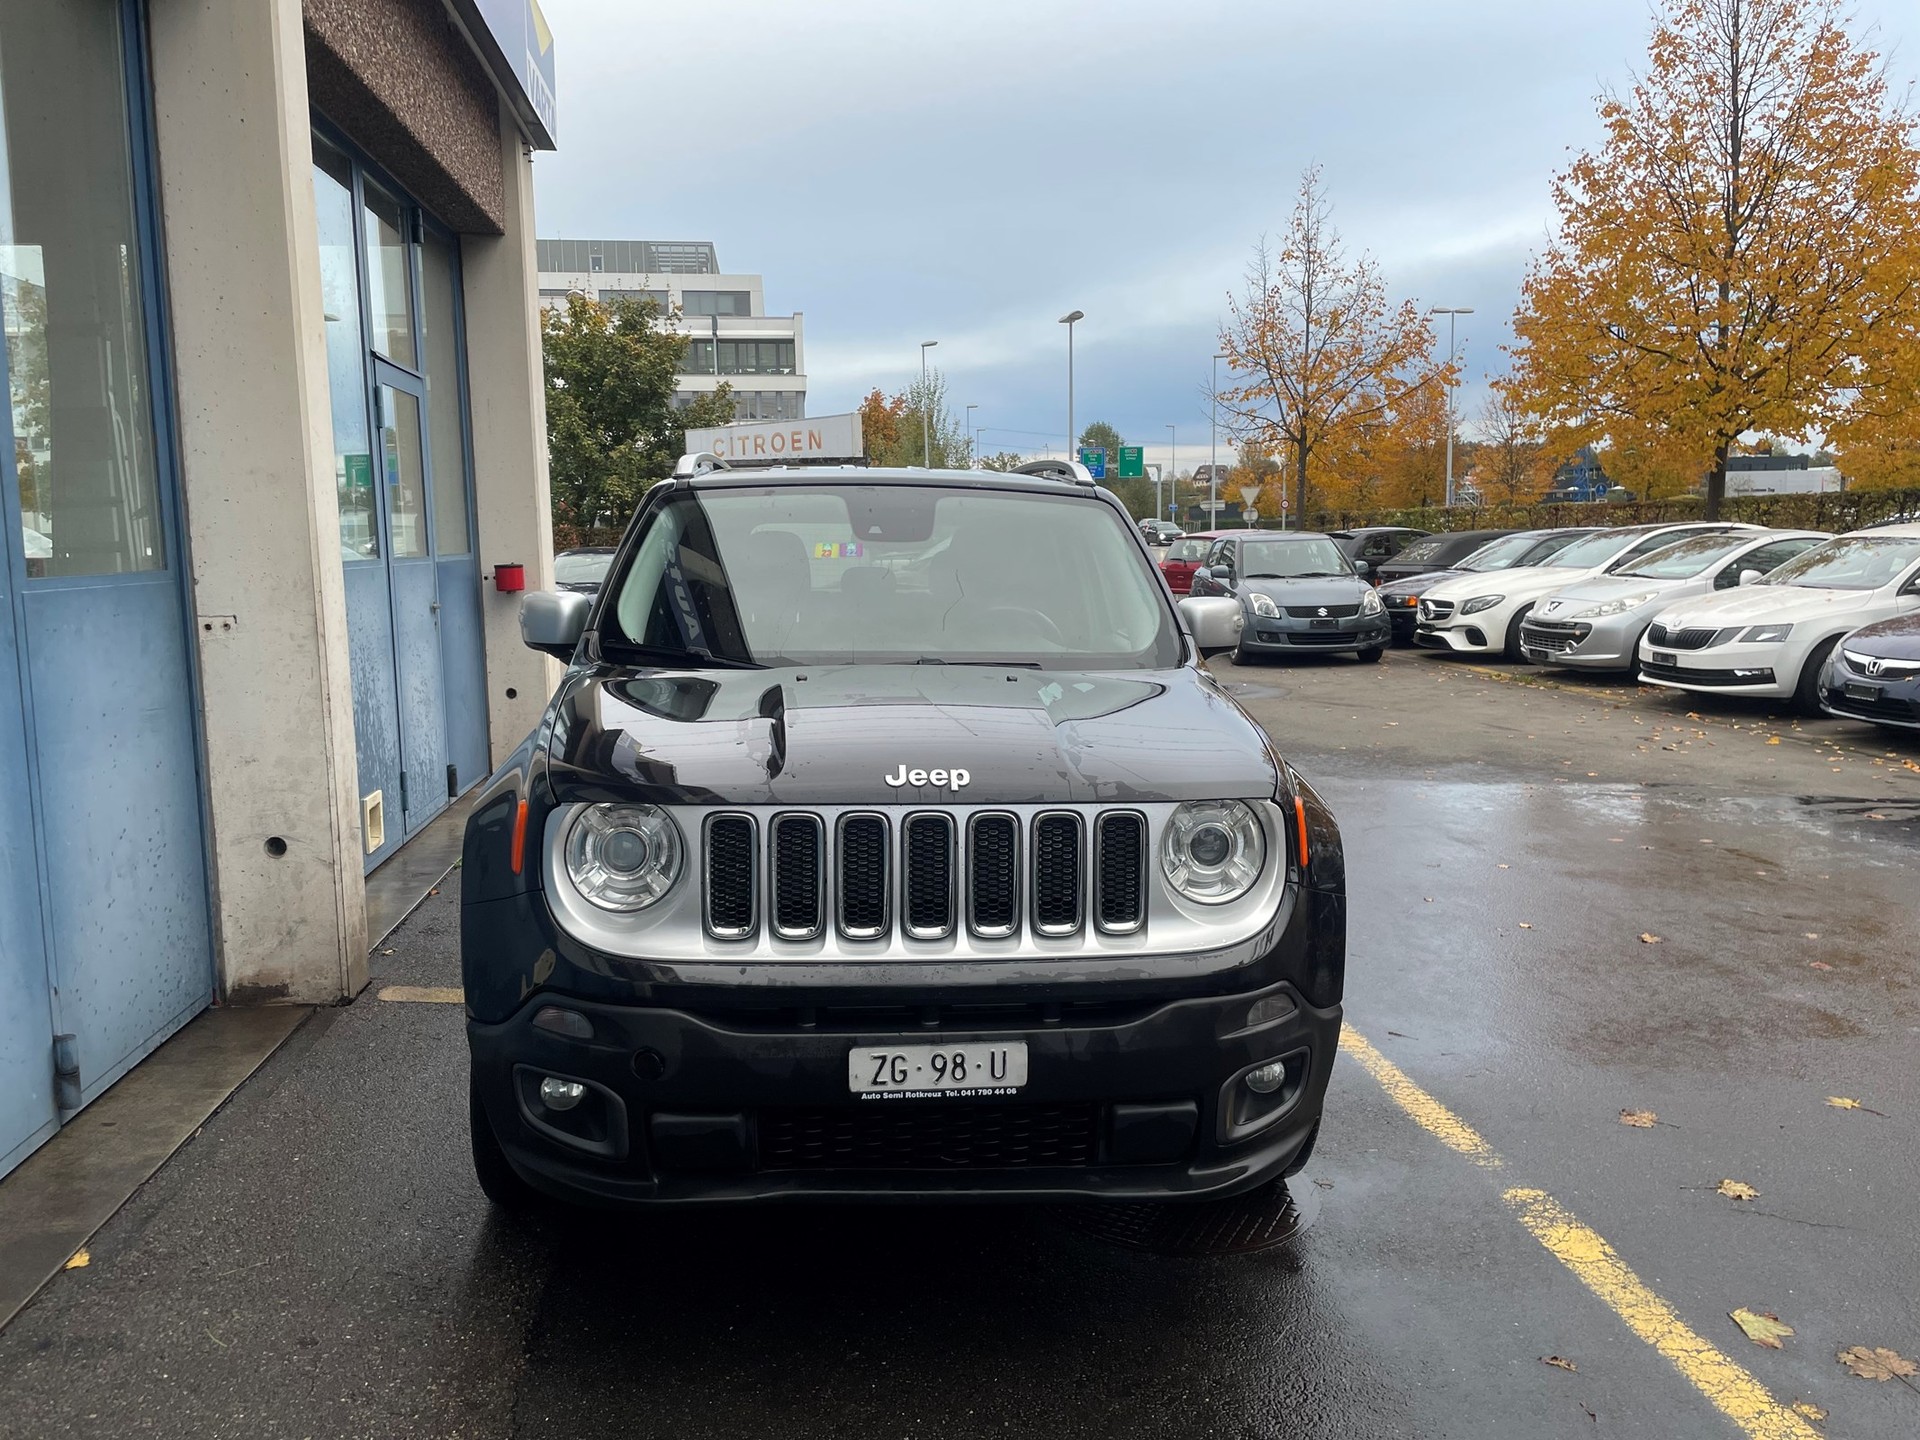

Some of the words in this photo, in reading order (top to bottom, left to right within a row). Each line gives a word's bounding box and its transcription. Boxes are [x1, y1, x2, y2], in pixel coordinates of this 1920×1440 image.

[528, 59, 557, 146] VARTA
[713, 429, 822, 457] CITROEN
[885, 764, 970, 791] Jeep
[861, 1092, 881, 1100] Auto
[961, 1089, 976, 1097] 041
